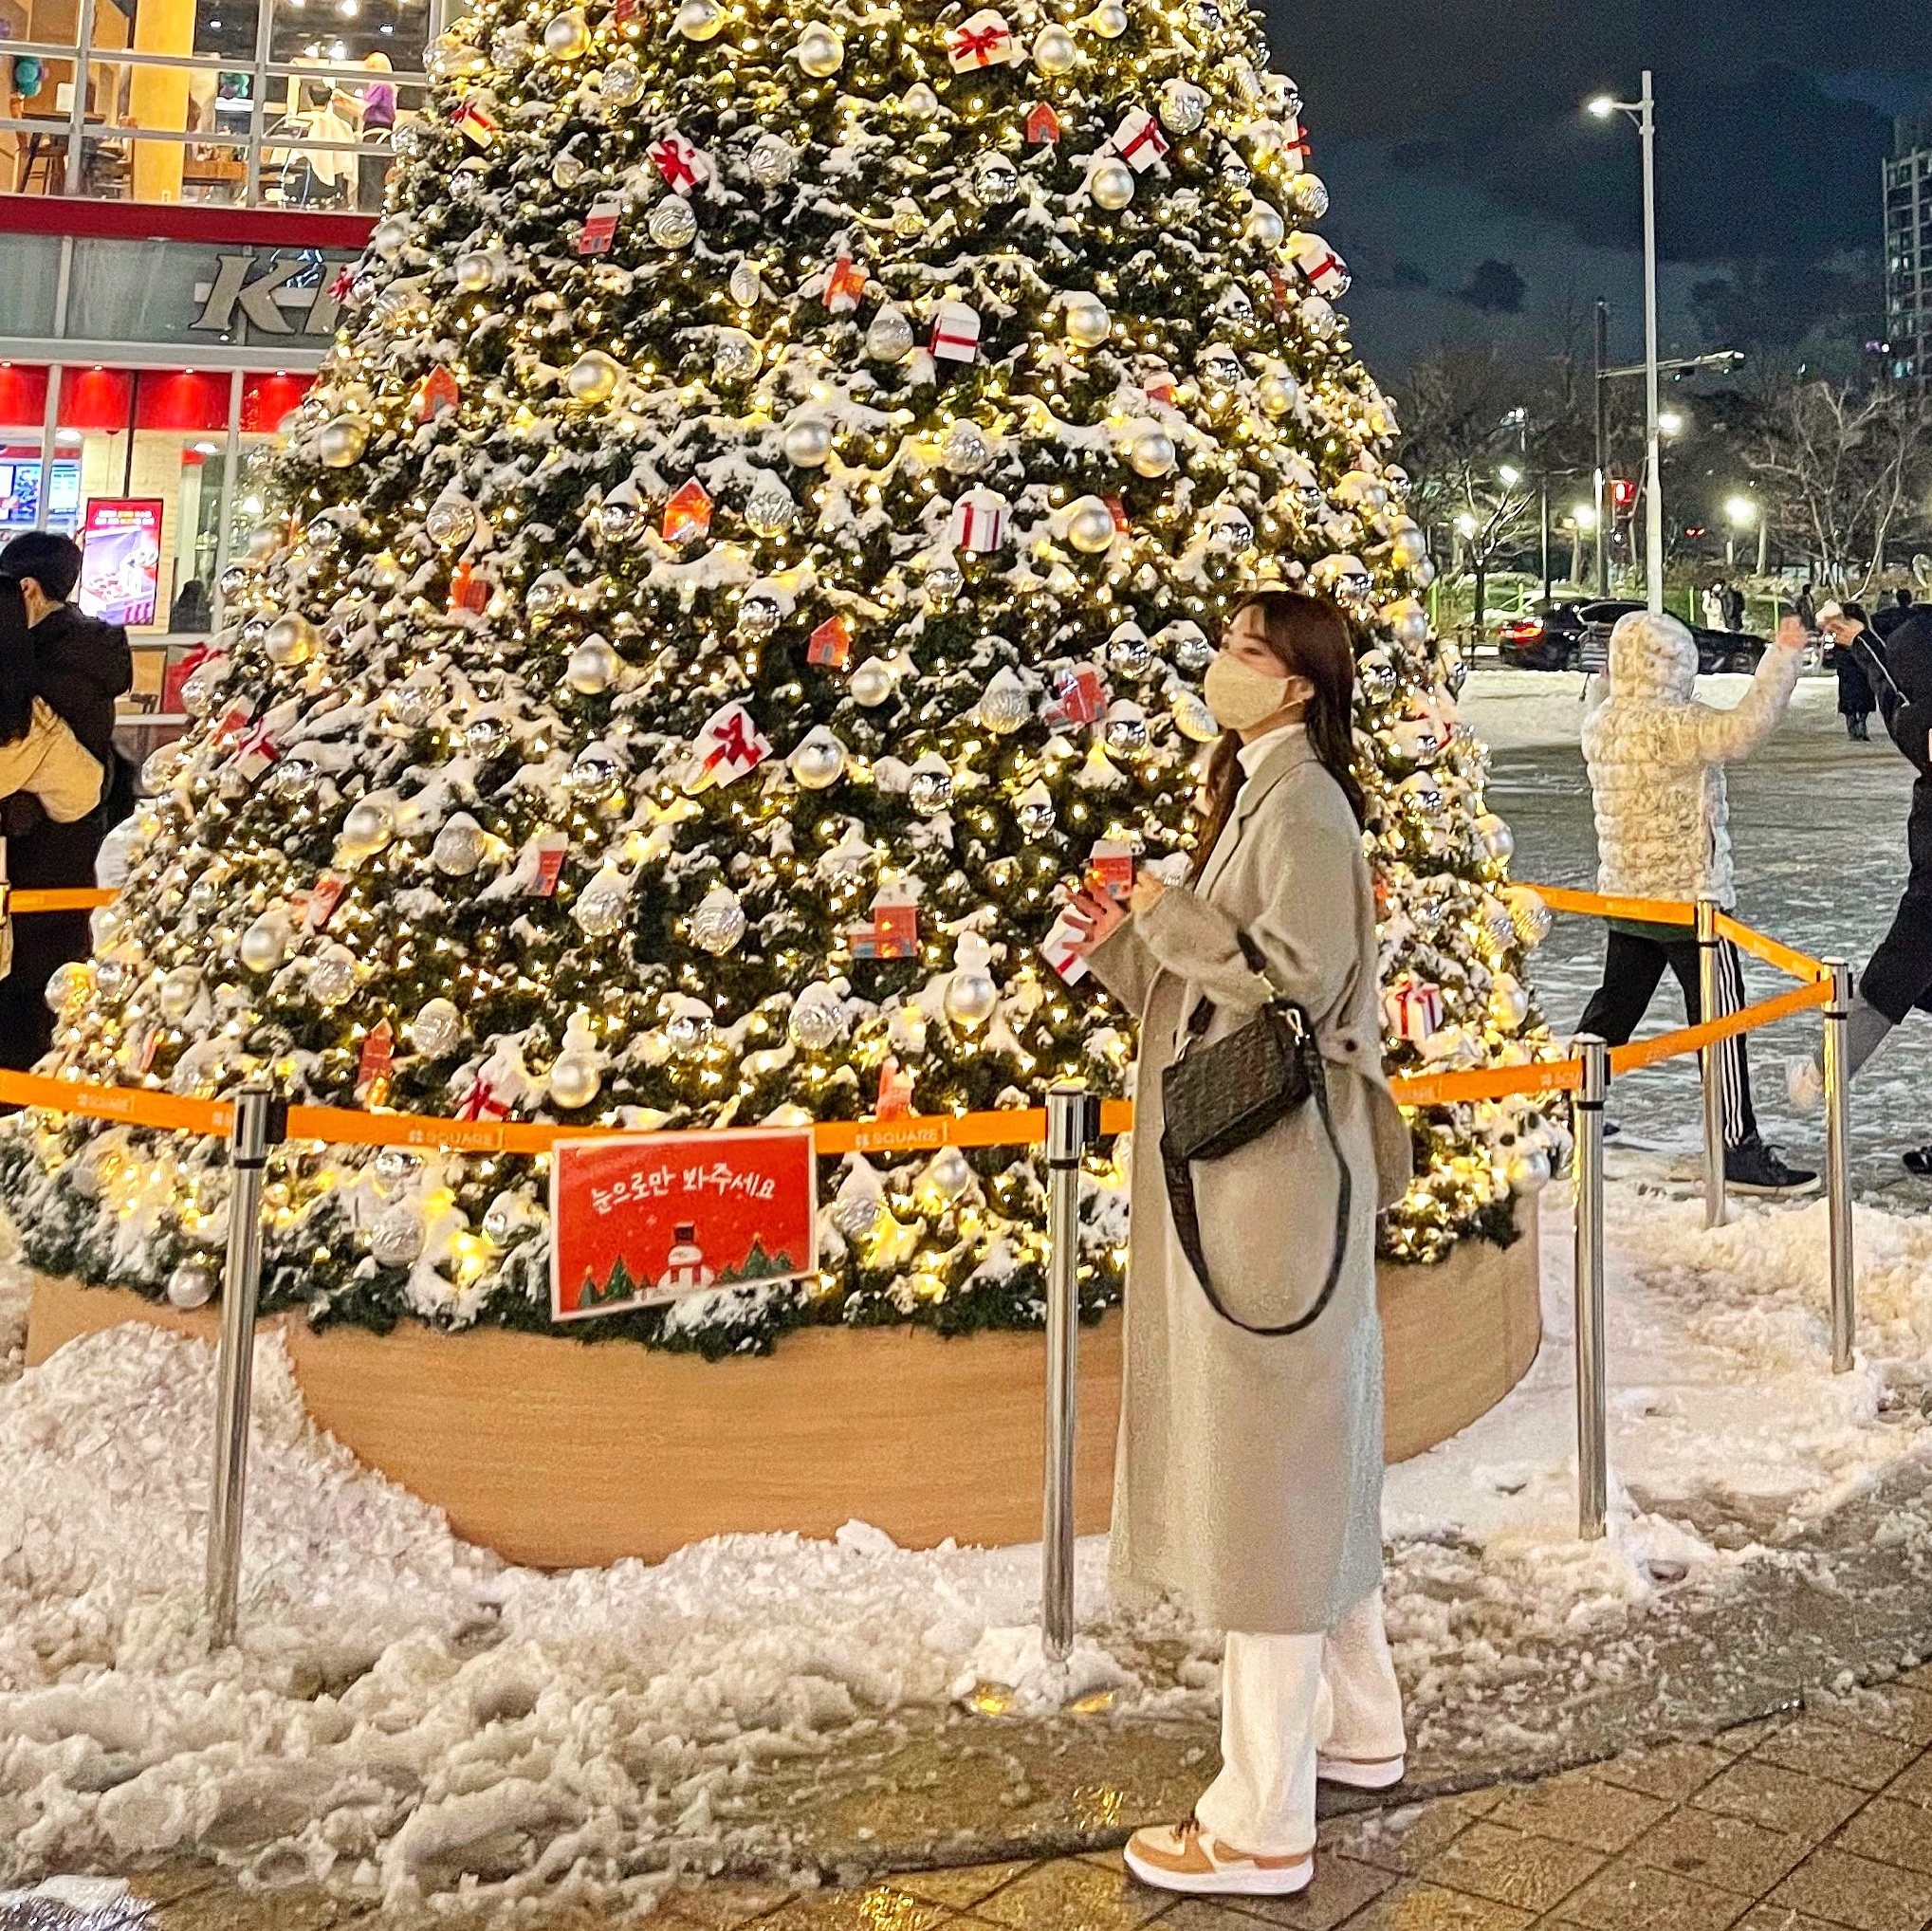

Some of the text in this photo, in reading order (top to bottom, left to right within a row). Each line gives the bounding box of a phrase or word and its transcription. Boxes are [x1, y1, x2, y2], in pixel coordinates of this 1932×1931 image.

[426, 1132, 492, 1148] SQUARE
[872, 1128, 938, 1146] SQUARE
[590, 1162, 777, 1215] 눈으로만 봐주세요
